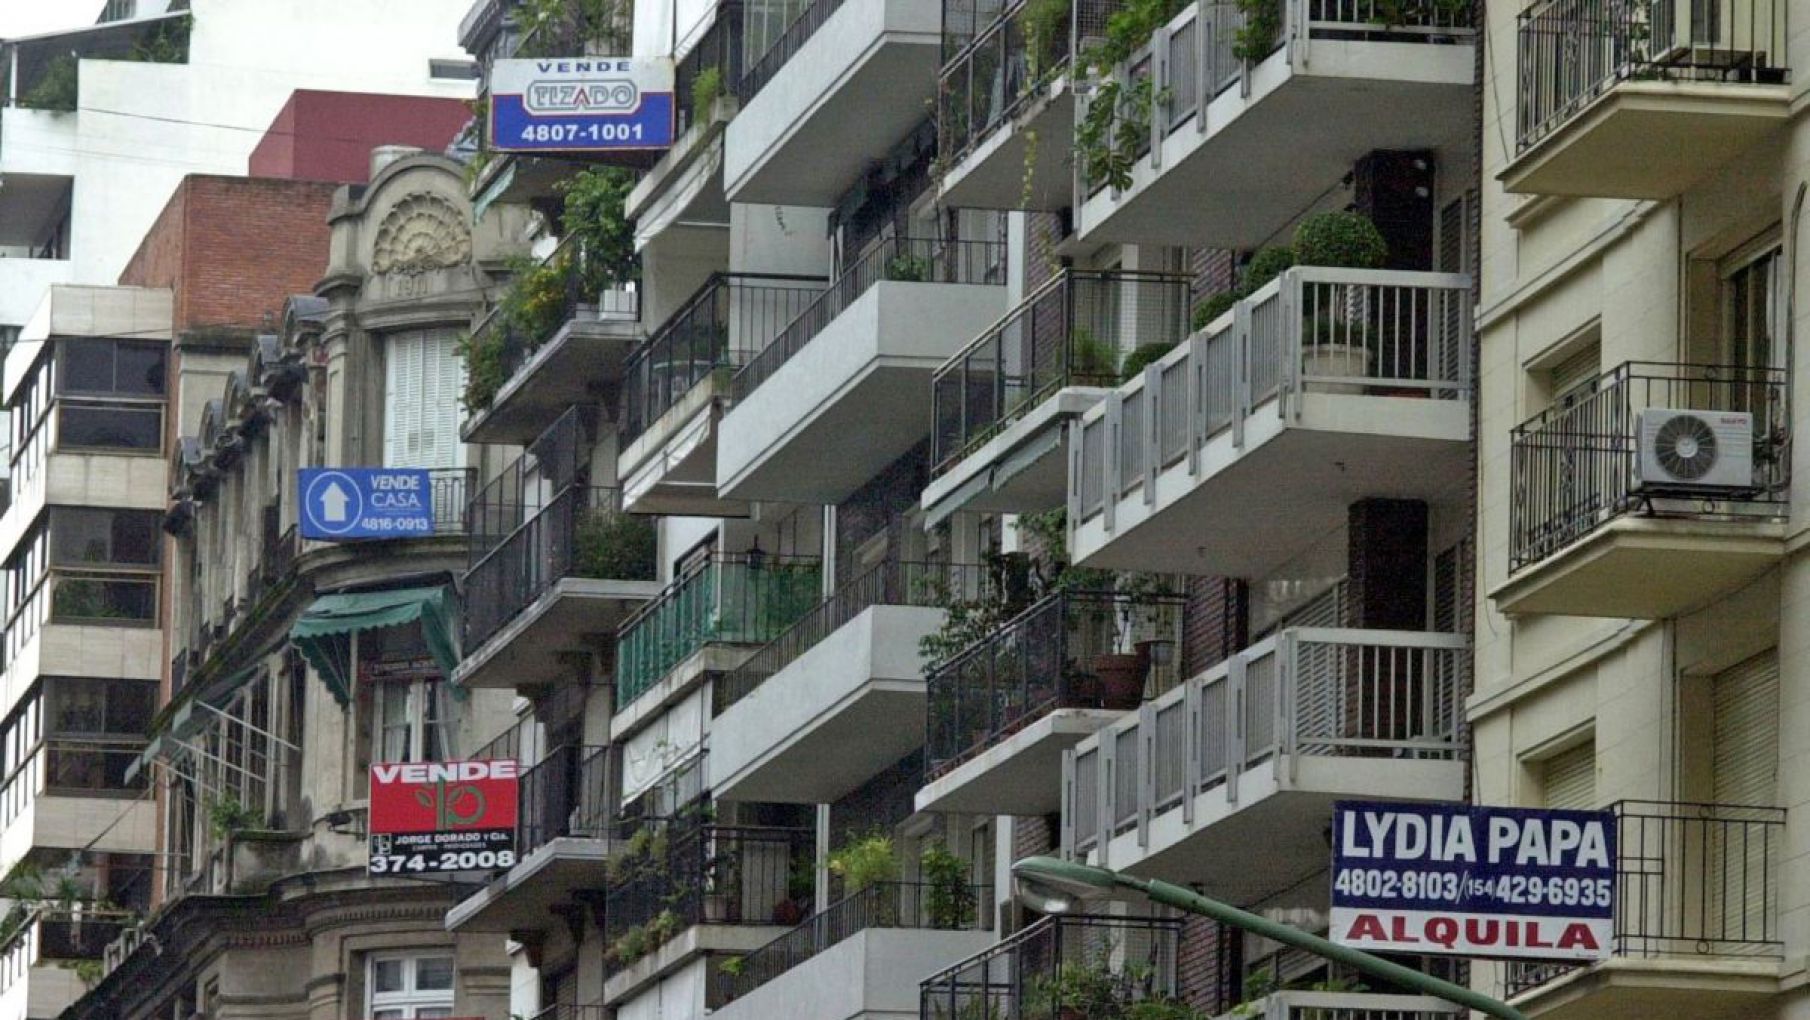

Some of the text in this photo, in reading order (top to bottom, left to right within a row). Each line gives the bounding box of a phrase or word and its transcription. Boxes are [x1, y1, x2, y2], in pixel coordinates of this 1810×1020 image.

[537, 61, 631, 73] VENDE
[533, 85, 634, 106] TIZADO
[521, 123, 642, 141] 4807-1001
[371, 474, 420, 490] VENDE
[371, 492, 421, 507] CASA
[361, 518, 428, 531] 4816-0913
[373, 760, 517, 783] VENDE
[395, 835, 432, 845] JORGE
[434, 832, 481, 843] DORADO
[1342, 810, 1609, 868] LYDIA PAPA
[370, 850, 516, 873] 374-2008
[1346, 914, 1599, 949] ALQUILA
